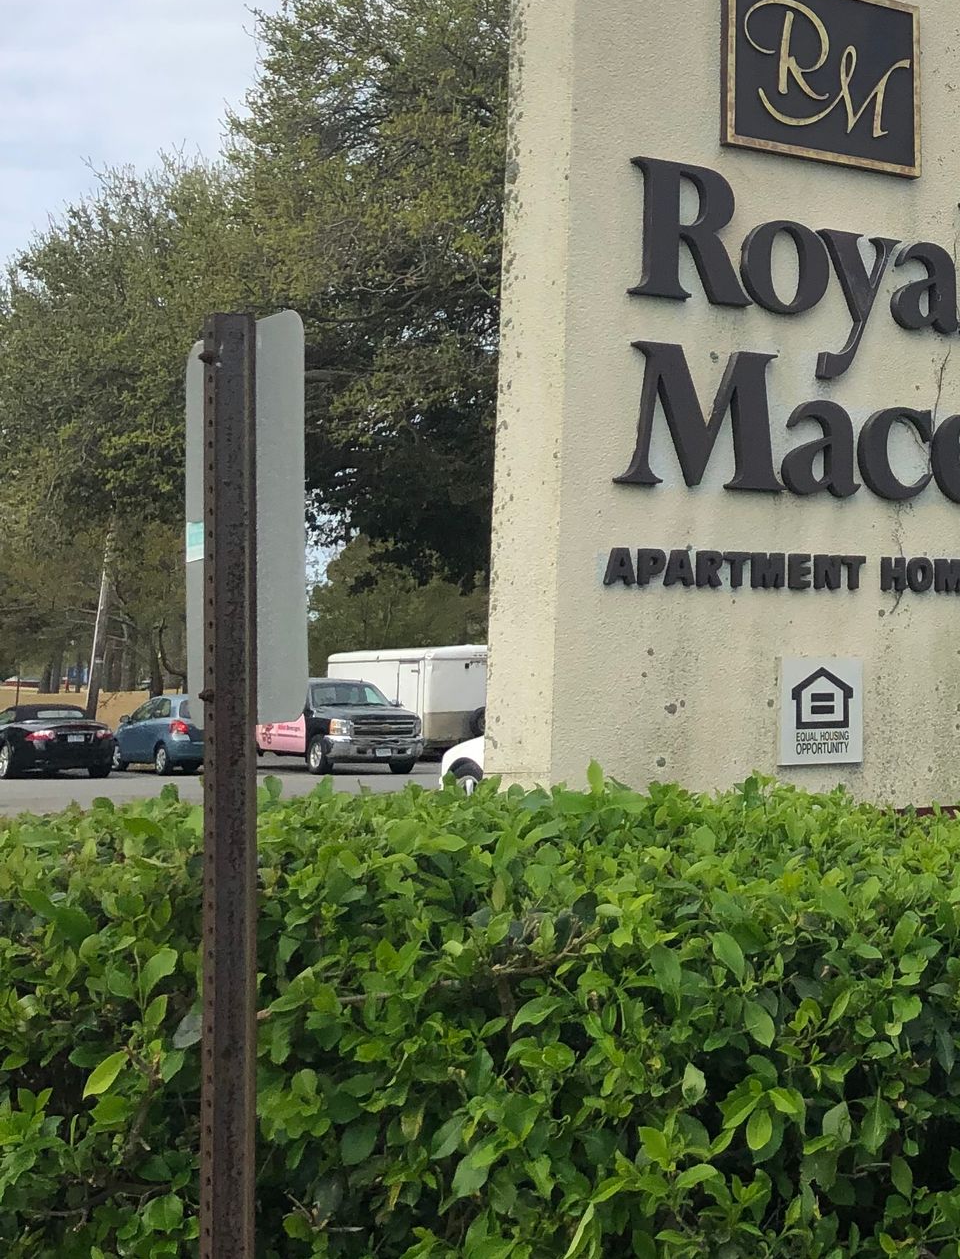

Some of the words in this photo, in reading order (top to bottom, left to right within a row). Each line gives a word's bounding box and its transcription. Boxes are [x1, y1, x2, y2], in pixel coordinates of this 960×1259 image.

[603, 547, 867, 590] APARTMENT
[796, 731, 818, 742] EQUAL
[820, 730, 849, 742] HOUSING
[796, 742, 849, 755] OPPORTUNITY
